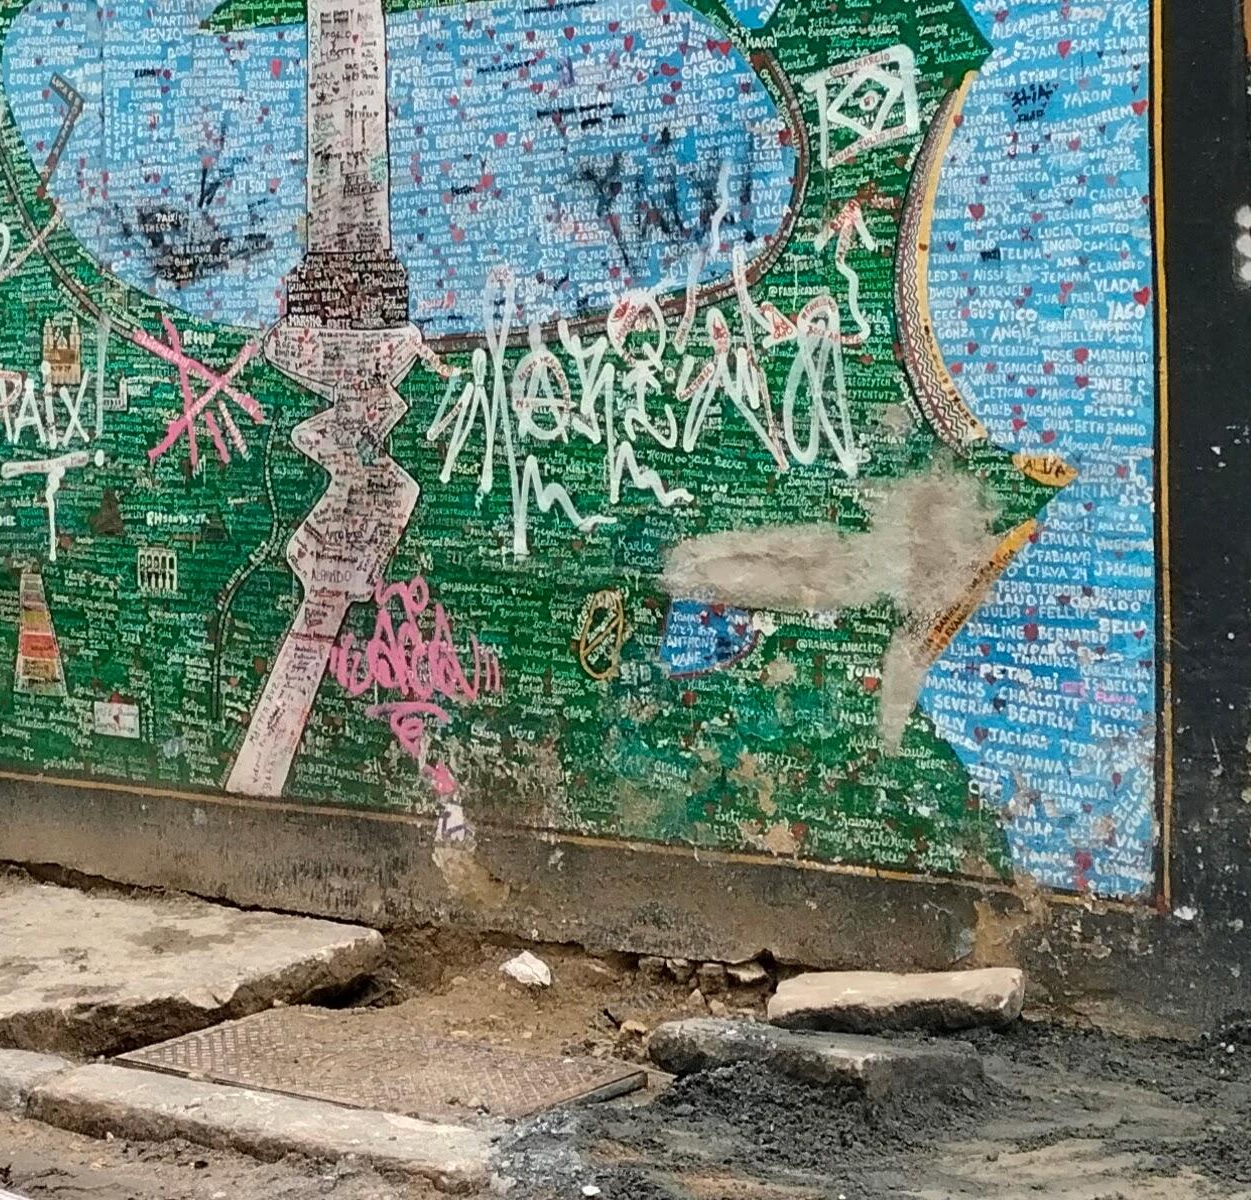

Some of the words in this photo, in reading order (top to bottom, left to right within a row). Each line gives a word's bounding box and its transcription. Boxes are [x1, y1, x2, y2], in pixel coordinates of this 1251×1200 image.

[1070, 38, 1100, 52] SAM
[1063, 88, 1112, 108] YARON
[1089, 186, 1139, 200] CAROLA
[998, 248, 1042, 261] TELMA
[1094, 279, 1139, 293] VLADA
[984, 750, 1066, 774] GEOVANNA
